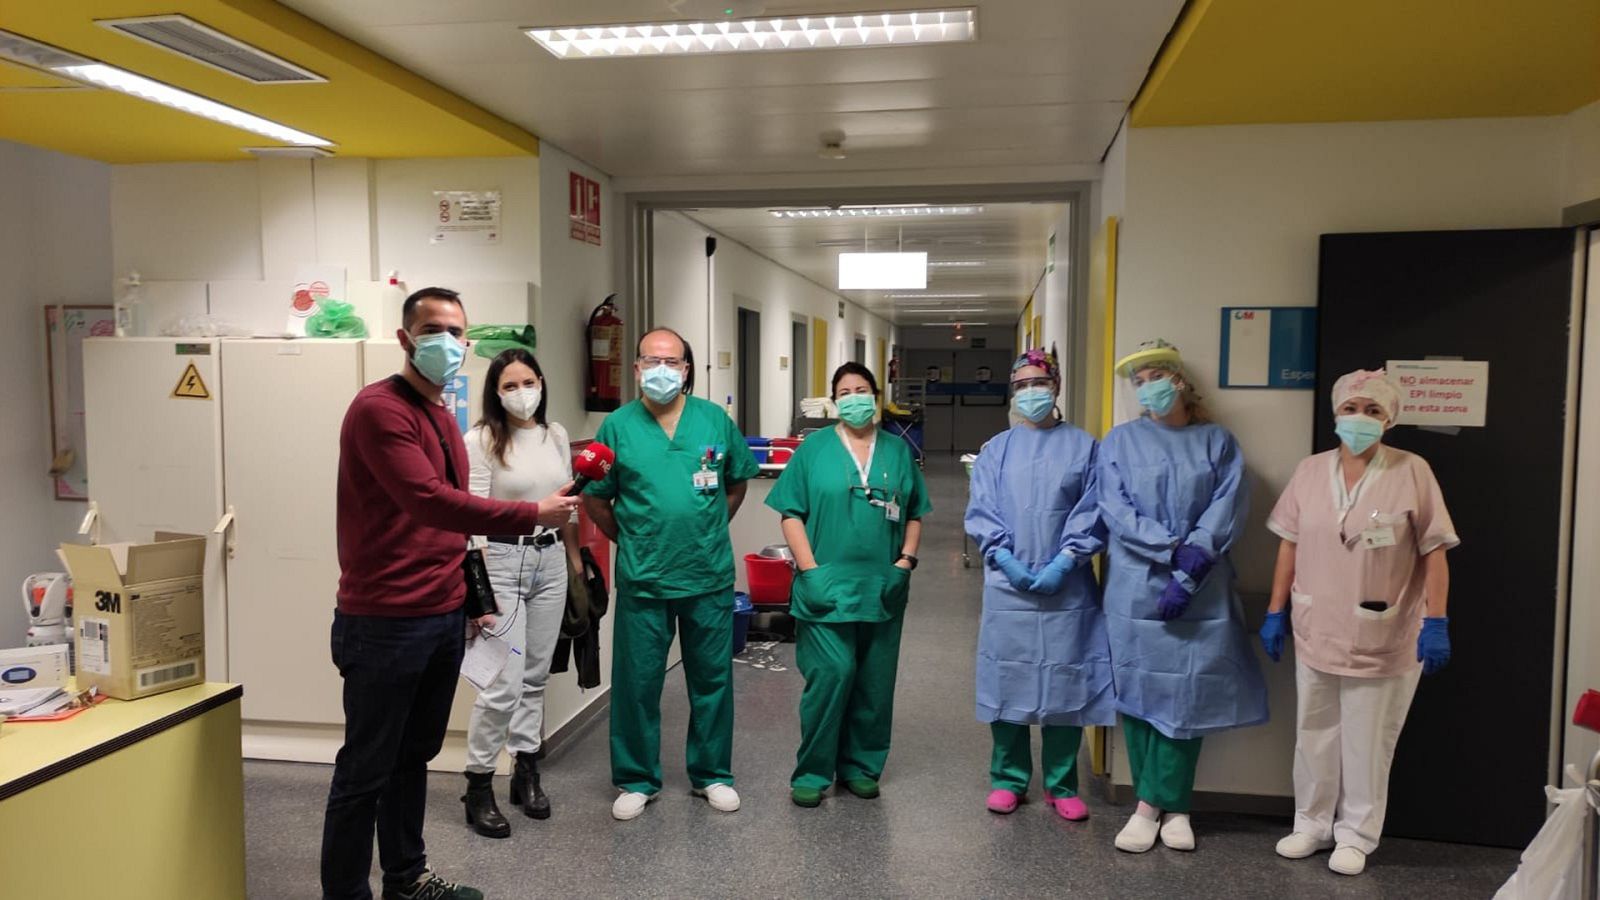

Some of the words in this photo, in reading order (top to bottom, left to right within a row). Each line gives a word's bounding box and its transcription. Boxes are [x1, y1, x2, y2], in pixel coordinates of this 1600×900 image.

[1400, 376, 1417, 385] NO
[1419, 376, 1474, 385] almacenar
[1410, 390, 1426, 398] EPI
[1429, 390, 1463, 399] limpio
[1418, 404, 1440, 412] esta
[95, 590, 121, 614] 3M
